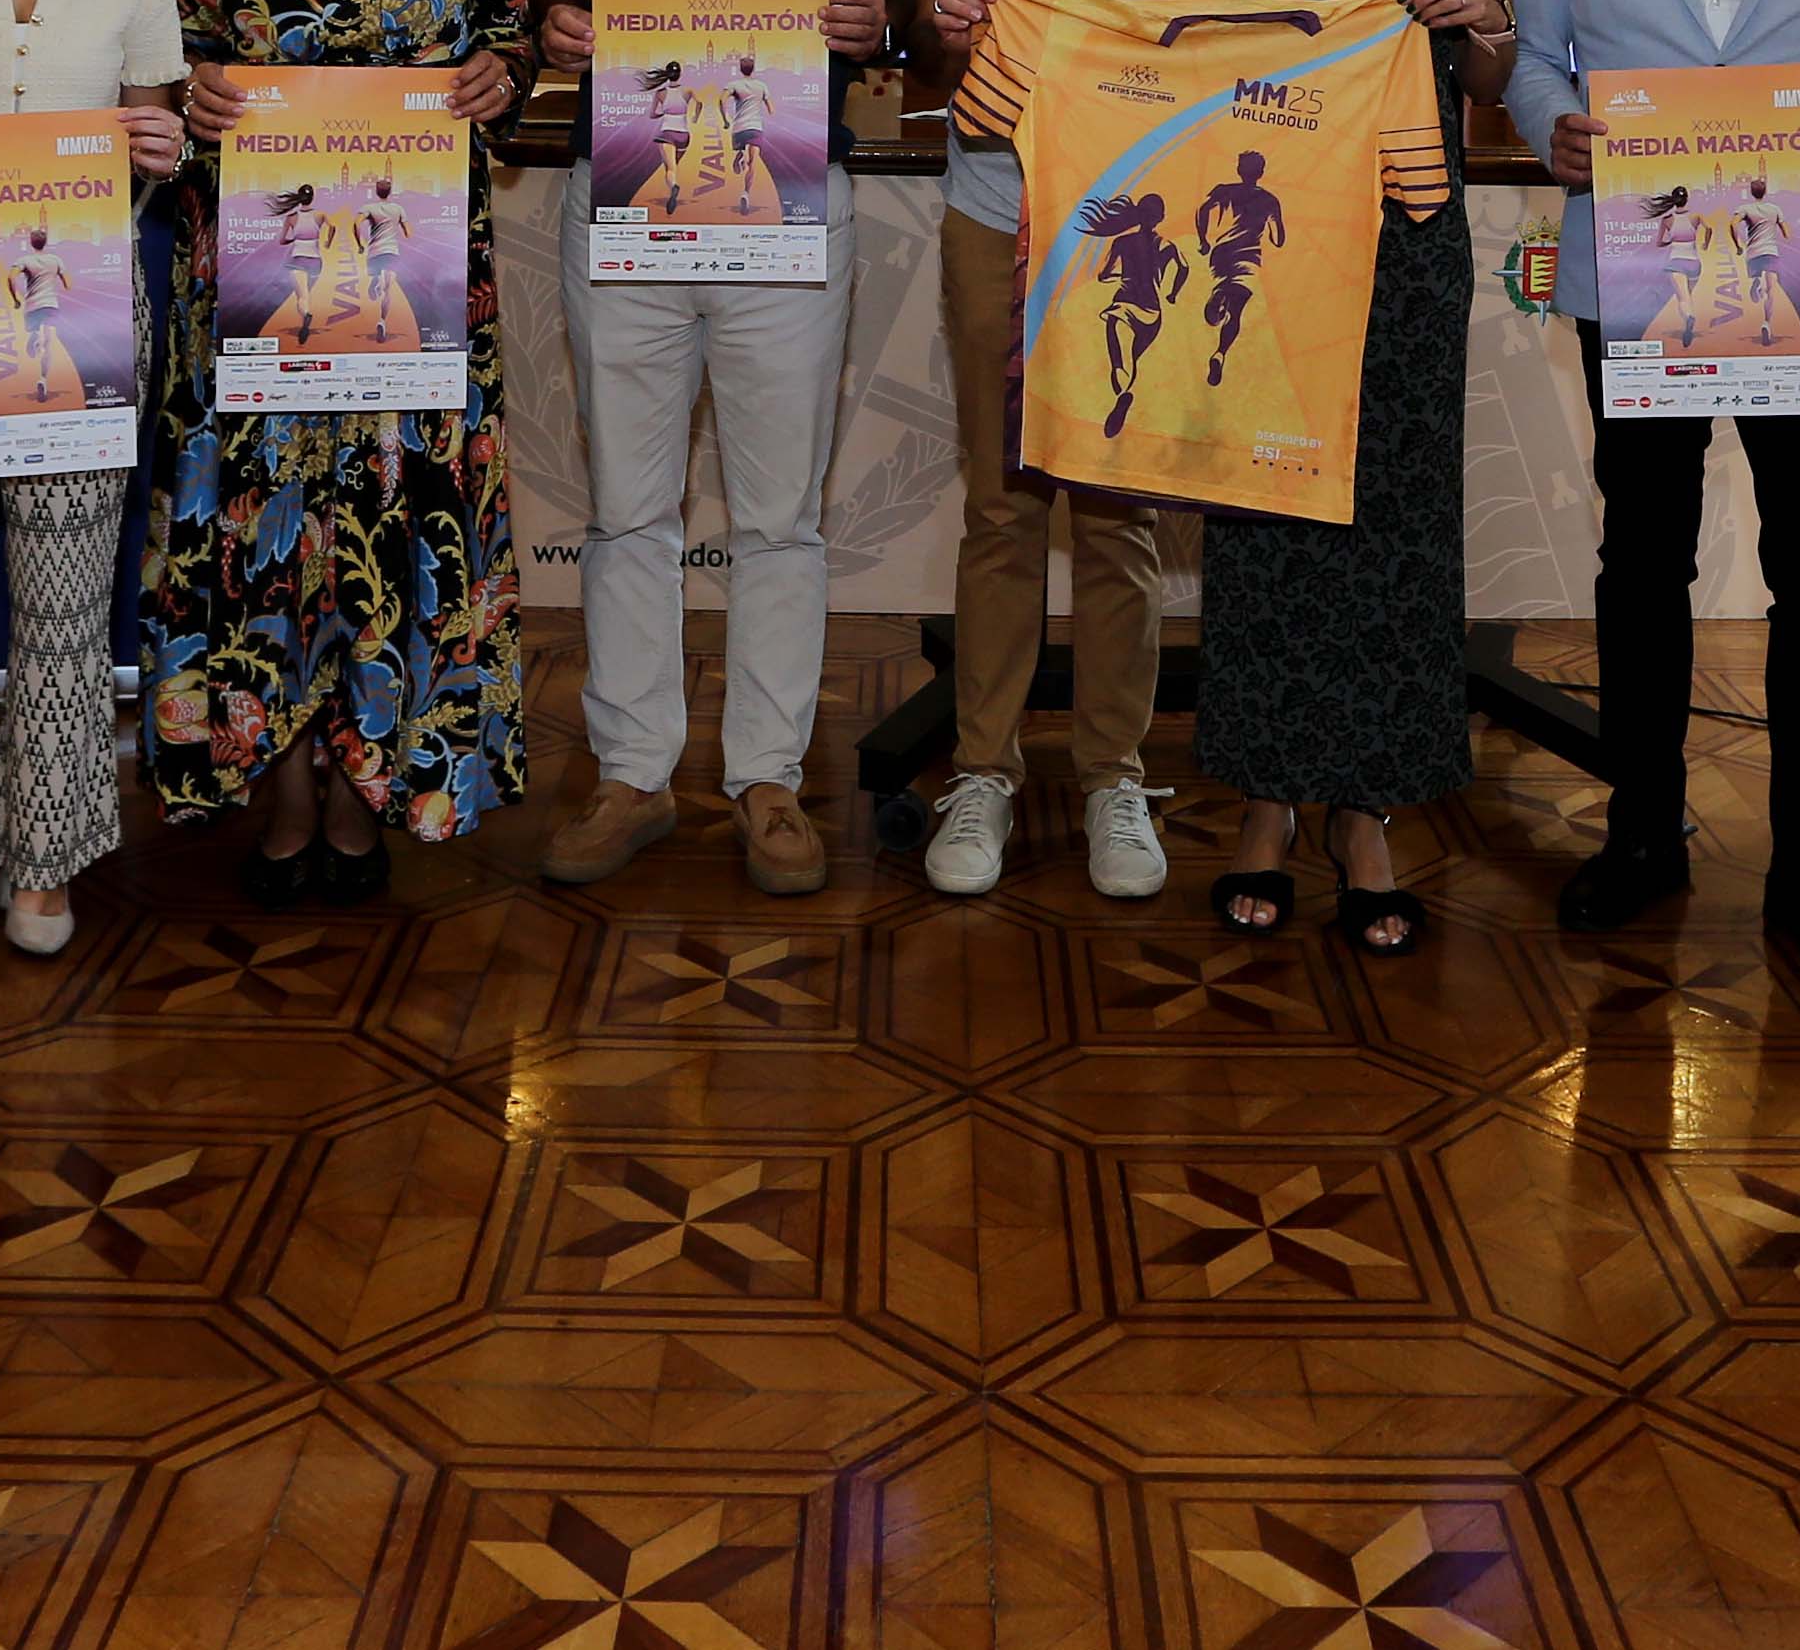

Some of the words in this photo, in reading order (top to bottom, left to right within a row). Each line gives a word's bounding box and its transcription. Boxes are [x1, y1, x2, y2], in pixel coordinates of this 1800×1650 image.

[688, 0, 733, 11] XXXVI
[606, 13, 684, 31] MEDIA
[692, 9, 814, 31] MARATÓN
[802, 84, 819, 94] 28
[616, 93, 653, 105] Legua
[1233, 78, 1324, 115] MM25
[600, 104, 647, 117] Popular
[322, 119, 370, 131] XXXVI
[1232, 107, 1319, 132] VALLADOLID
[1691, 119, 1741, 132] XXXVI
[56, 135, 112, 156] MMVA25
[236, 134, 317, 153] MEDIA
[326, 130, 453, 152] MARATÓN
[1607, 138, 1689, 157] MEDIA
[441, 205, 458, 216] 28
[244, 218, 283, 231] Legua
[1621, 221, 1658, 233] Legua
[227, 230, 277, 244] Popular
[1605, 233, 1653, 246] Popular
[104, 253, 121, 266] 28
